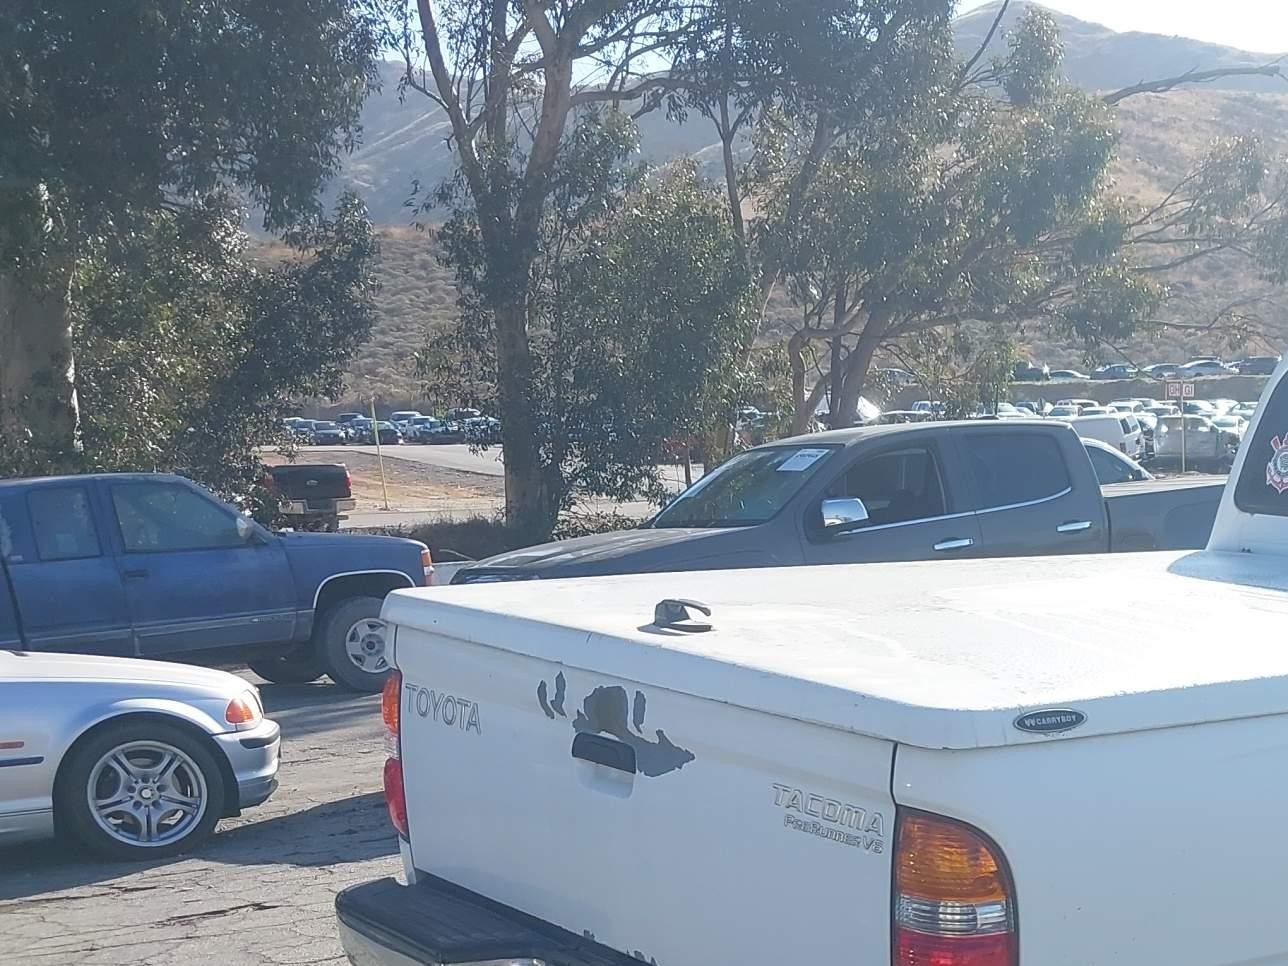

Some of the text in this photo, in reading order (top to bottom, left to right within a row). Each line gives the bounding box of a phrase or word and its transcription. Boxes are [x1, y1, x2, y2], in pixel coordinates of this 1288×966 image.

[405, 682, 482, 736] TOYOTA
[772, 783, 884, 837] TACOMA
[863, 835, 884, 854] V6
